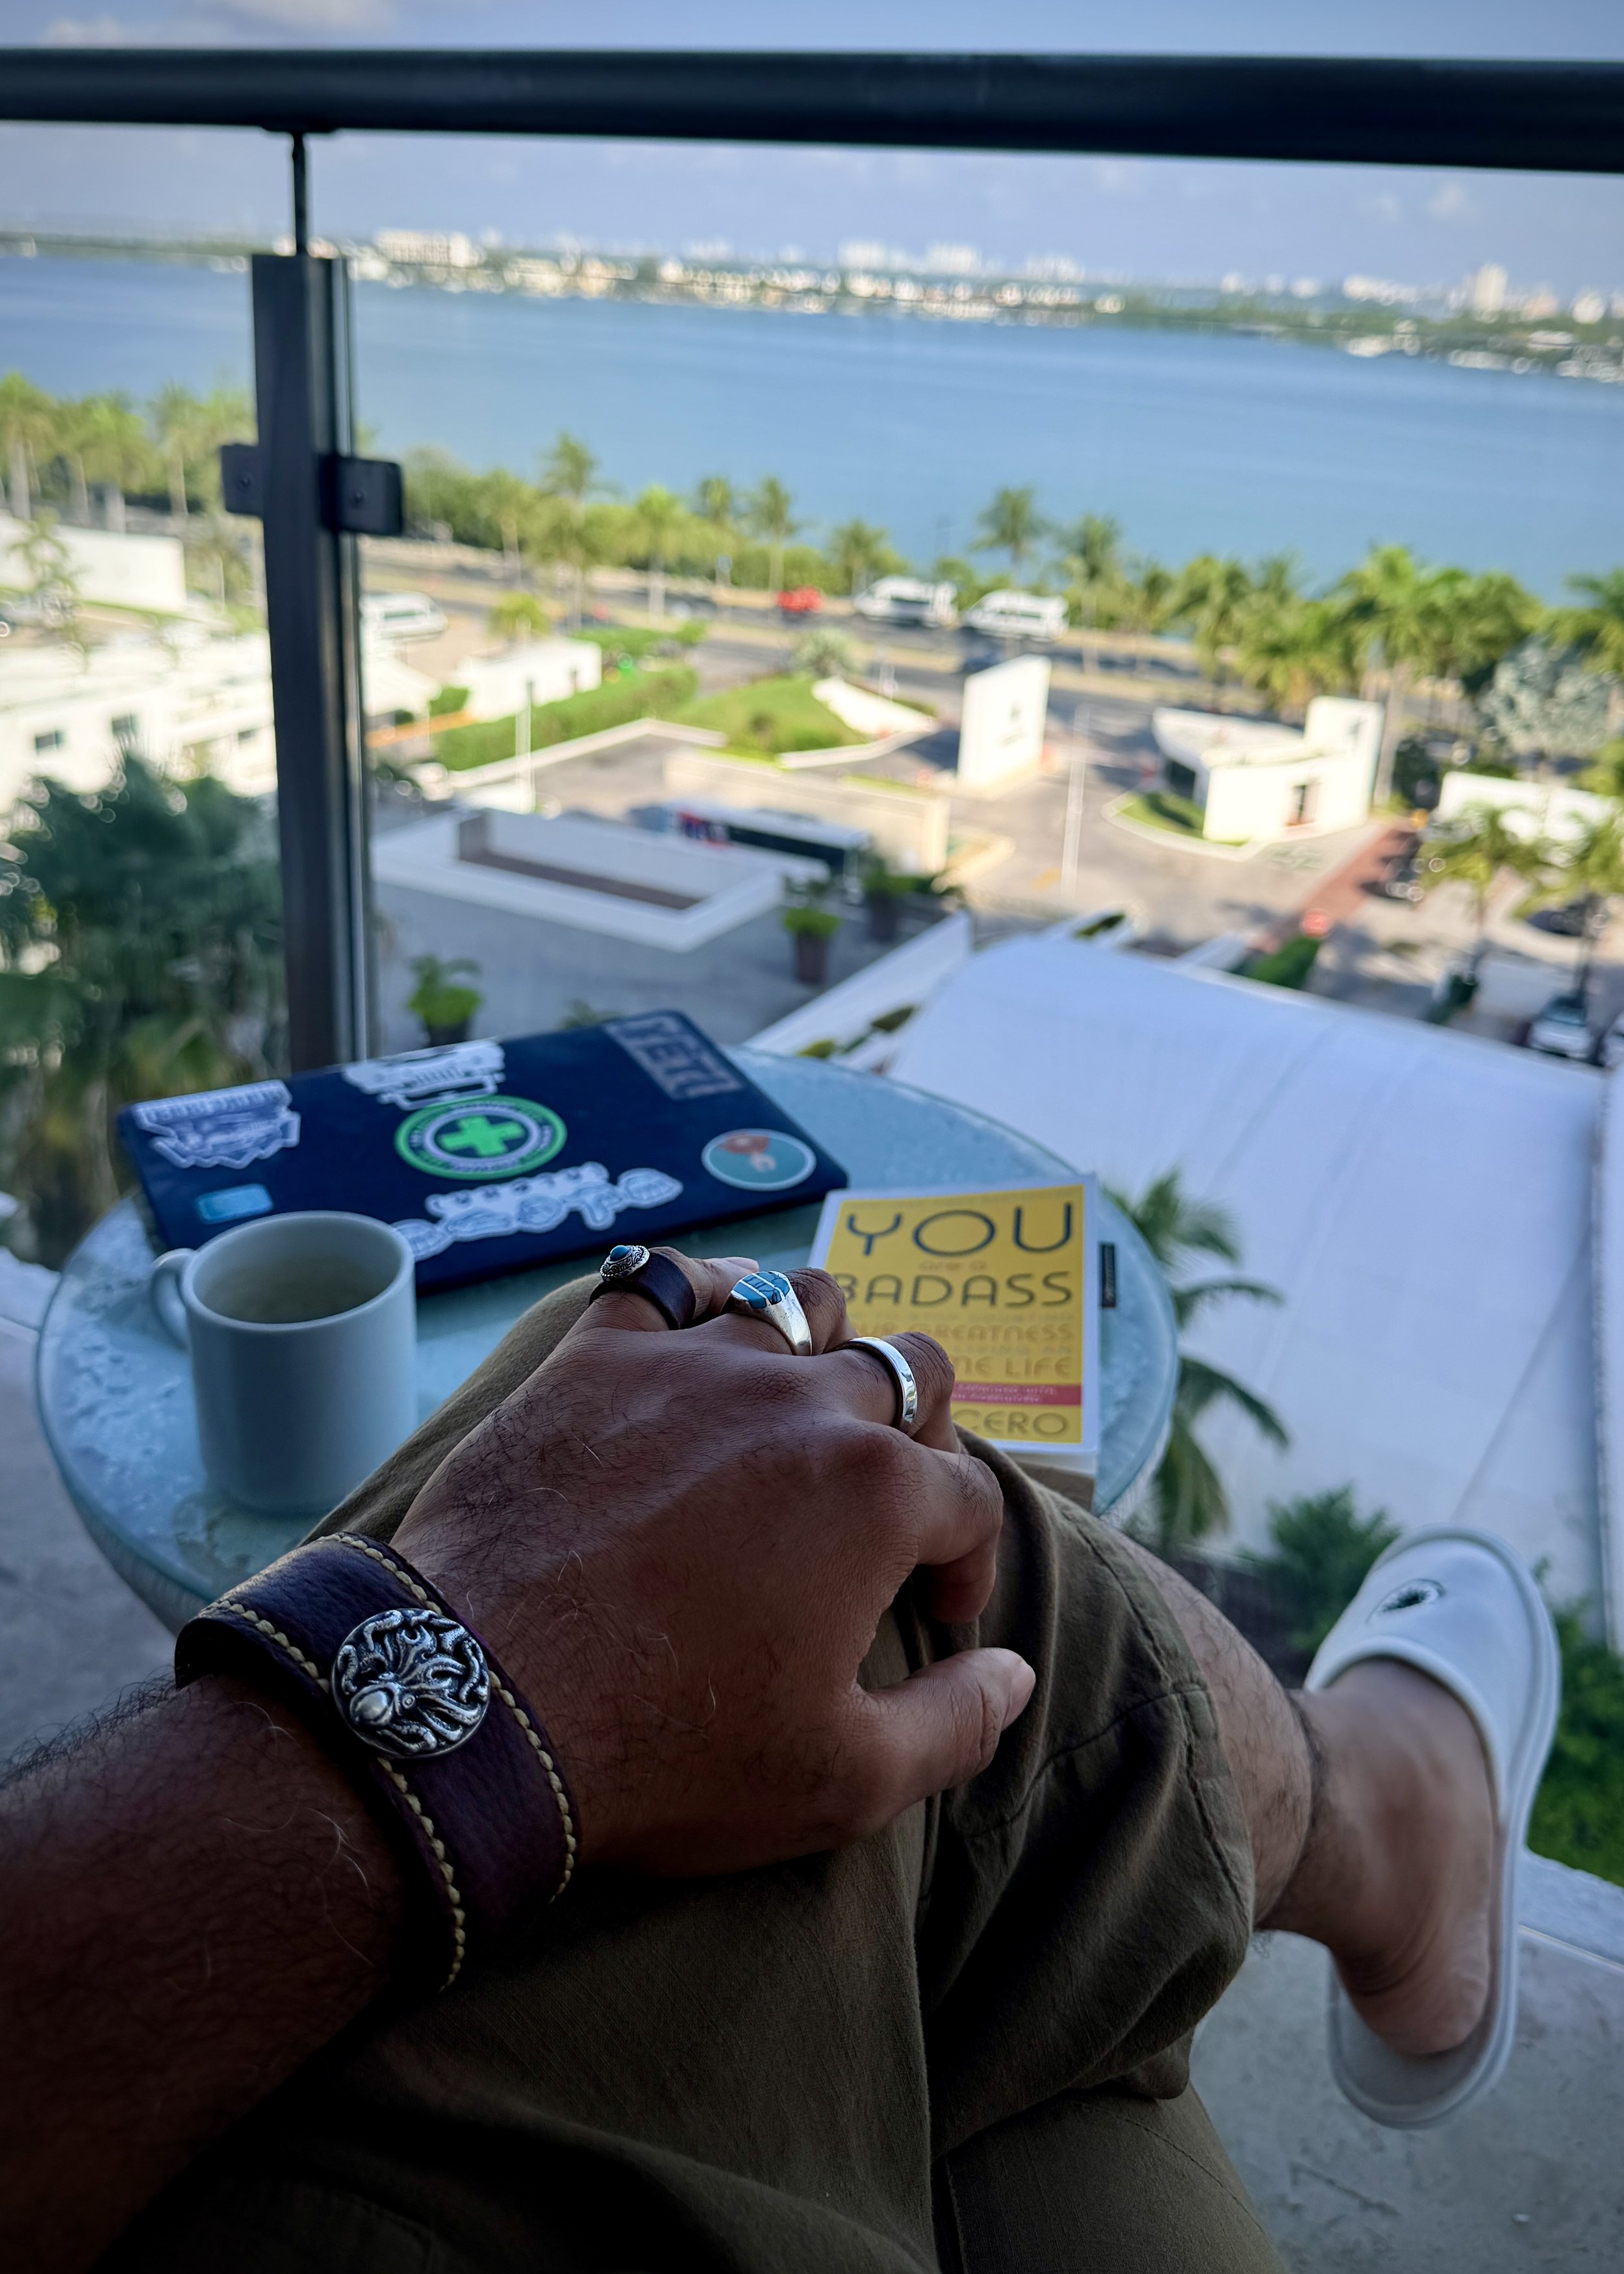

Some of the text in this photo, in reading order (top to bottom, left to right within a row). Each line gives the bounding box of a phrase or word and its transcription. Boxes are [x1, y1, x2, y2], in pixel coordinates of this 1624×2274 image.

[846, 1202, 1073, 1257] YOU
[833, 1270, 1073, 1309] BADASS
[1005, 1356, 1073, 1378] LIFE
[952, 1409, 1067, 1436] CERO
